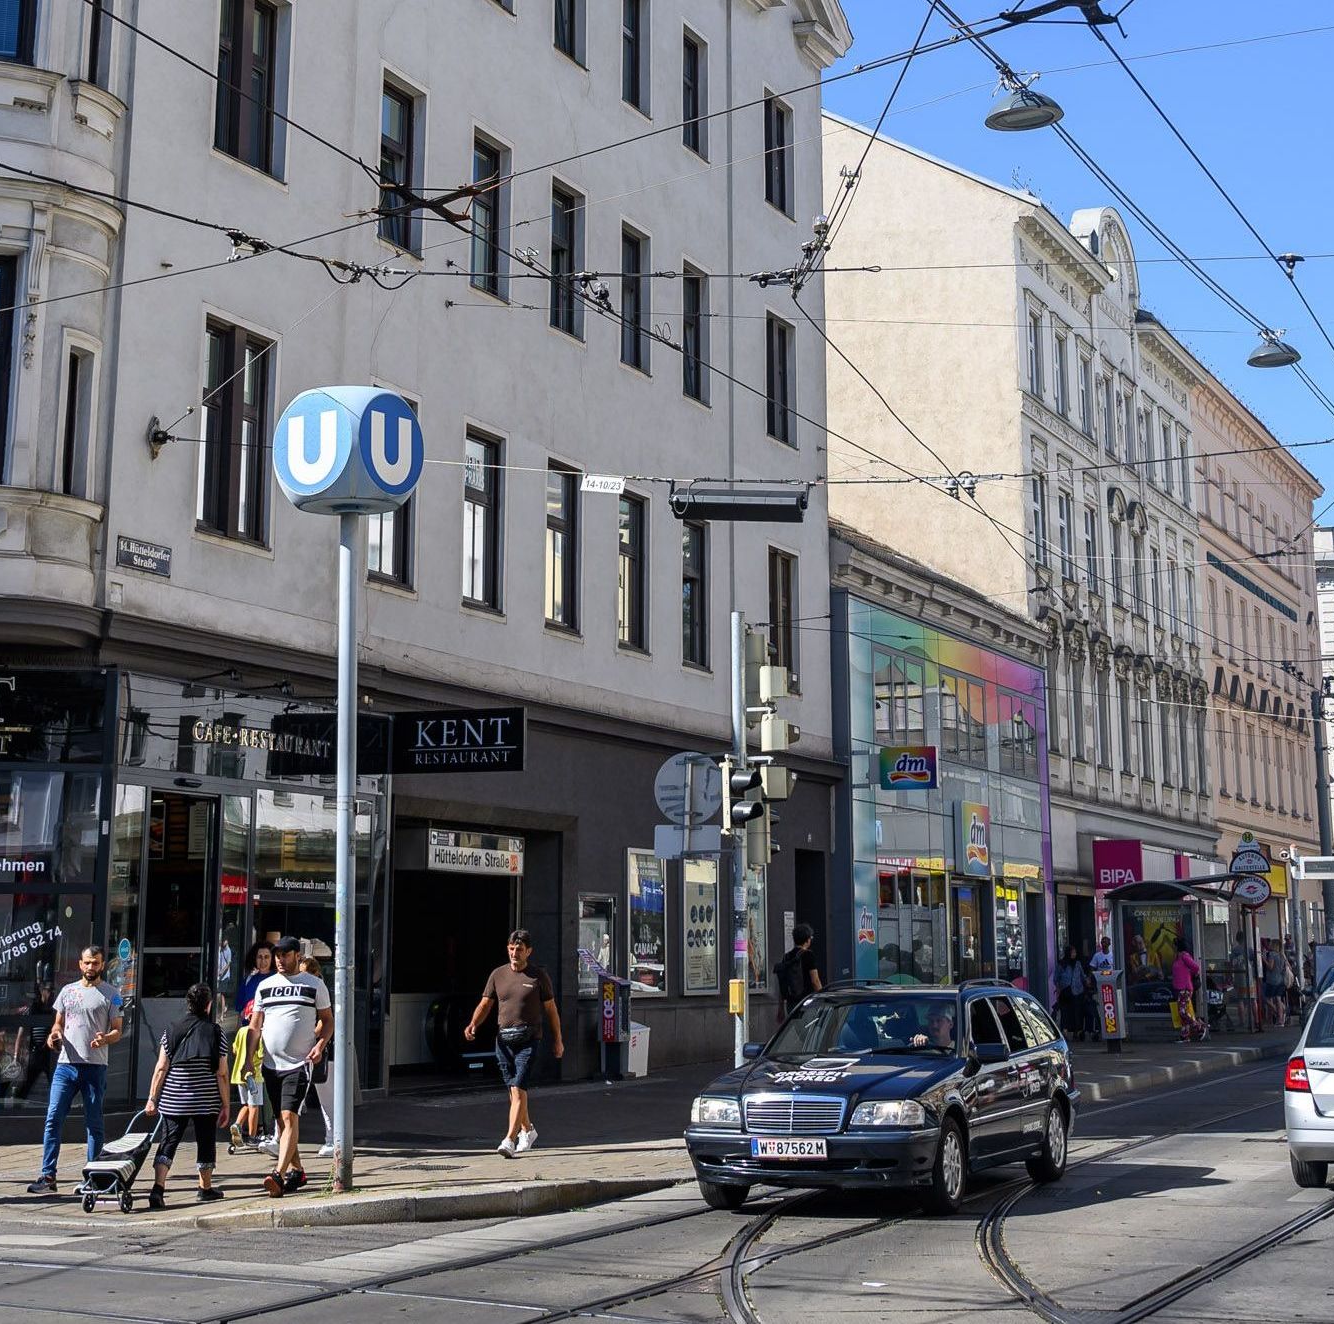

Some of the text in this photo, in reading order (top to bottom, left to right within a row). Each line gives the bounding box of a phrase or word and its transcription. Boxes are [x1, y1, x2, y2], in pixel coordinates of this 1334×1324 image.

[287, 409, 337, 486] U
[370, 410, 412, 486] U
[586, 479, 622, 492] 14-10/23
[130, 542, 171, 562] Hütteldorfer
[133, 554, 158, 570] Straße
[416, 716, 511, 748] KENT
[239, 727, 331, 758] RESTAURANT
[415, 750, 511, 765] RESTAURANT
[895, 752, 927, 773] dm
[969, 812, 987, 847] dm
[434, 848, 509, 868] Hütteldorfer Straße
[274, 877, 284, 888] Alle
[1100, 868, 1136, 884] BIPA
[29, 933, 46, 950] 62
[45, 924, 63, 943] 74
[269, 986, 302, 997] ICON
[603, 983, 615, 1019] oe24
[1104, 1002, 1116, 1033] oe24
[774, 1075, 837, 1083] JACKED
[759, 1142, 825, 1155] W 87562 M
